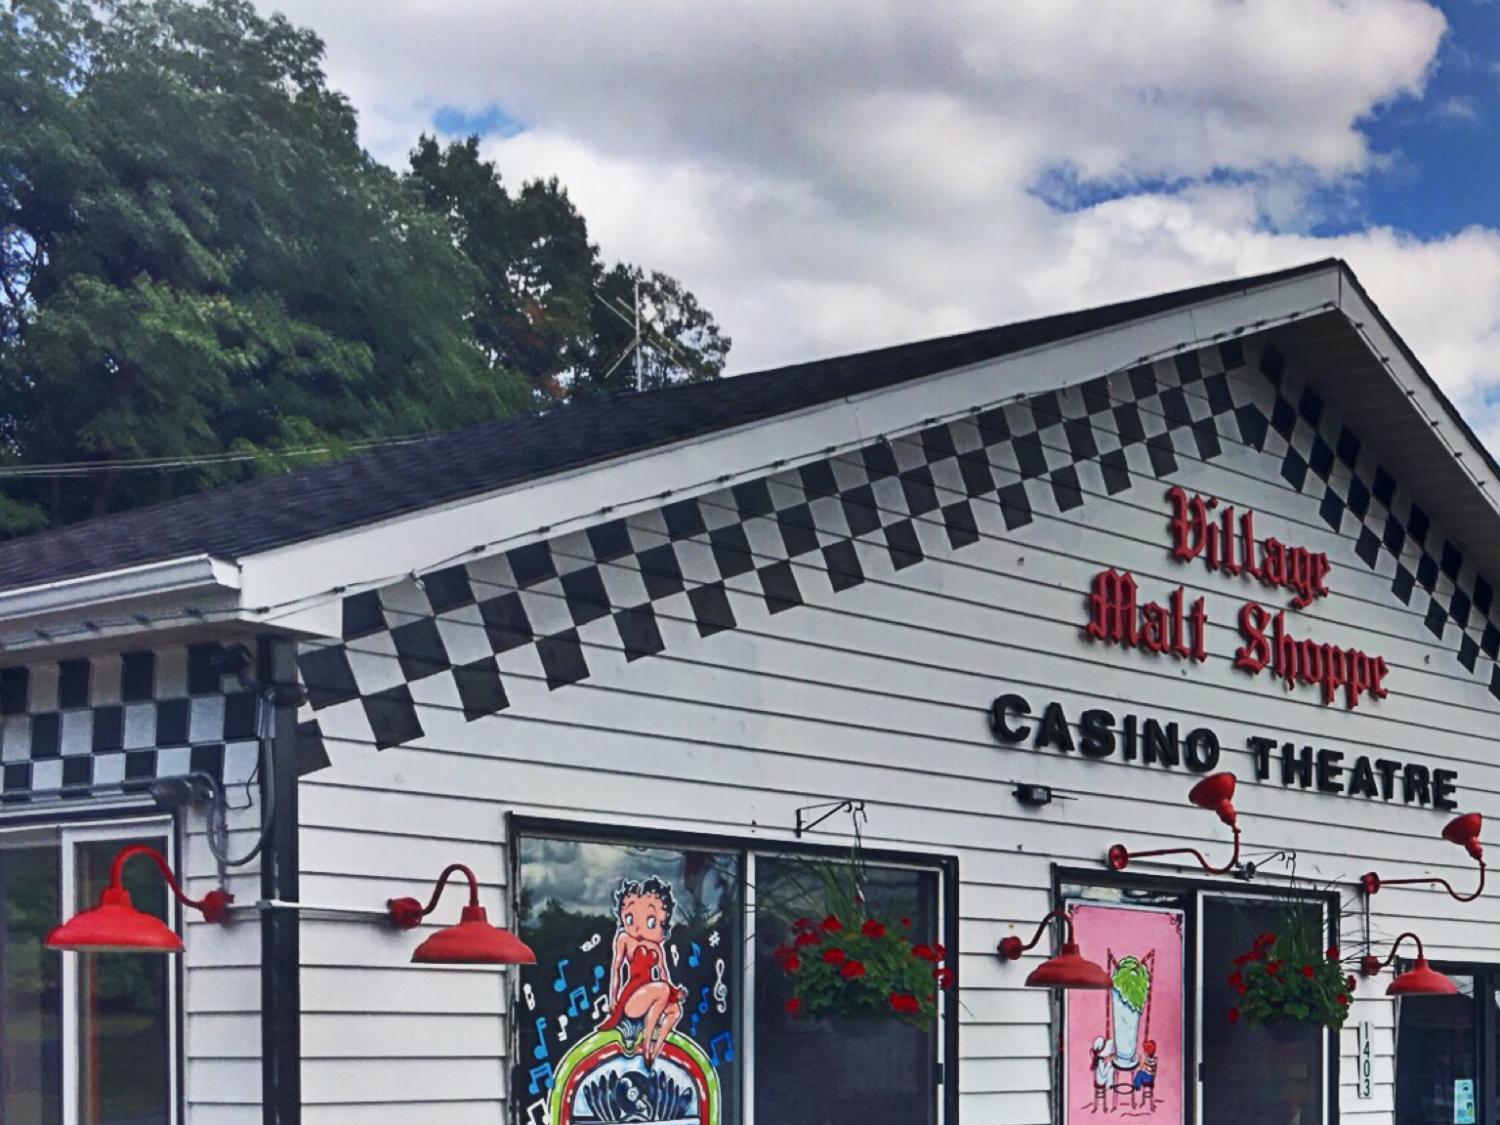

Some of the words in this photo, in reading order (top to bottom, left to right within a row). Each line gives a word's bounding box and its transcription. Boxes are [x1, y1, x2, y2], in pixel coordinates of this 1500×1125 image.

[1167, 486, 1331, 608] Village
[1086, 568, 1208, 662] Malt
[1236, 602, 1389, 708] Shoppe
[991, 693, 1220, 772] CASINO
[1248, 734, 1458, 810] THEATRE
[1363, 1021, 1371, 1097] 1403
